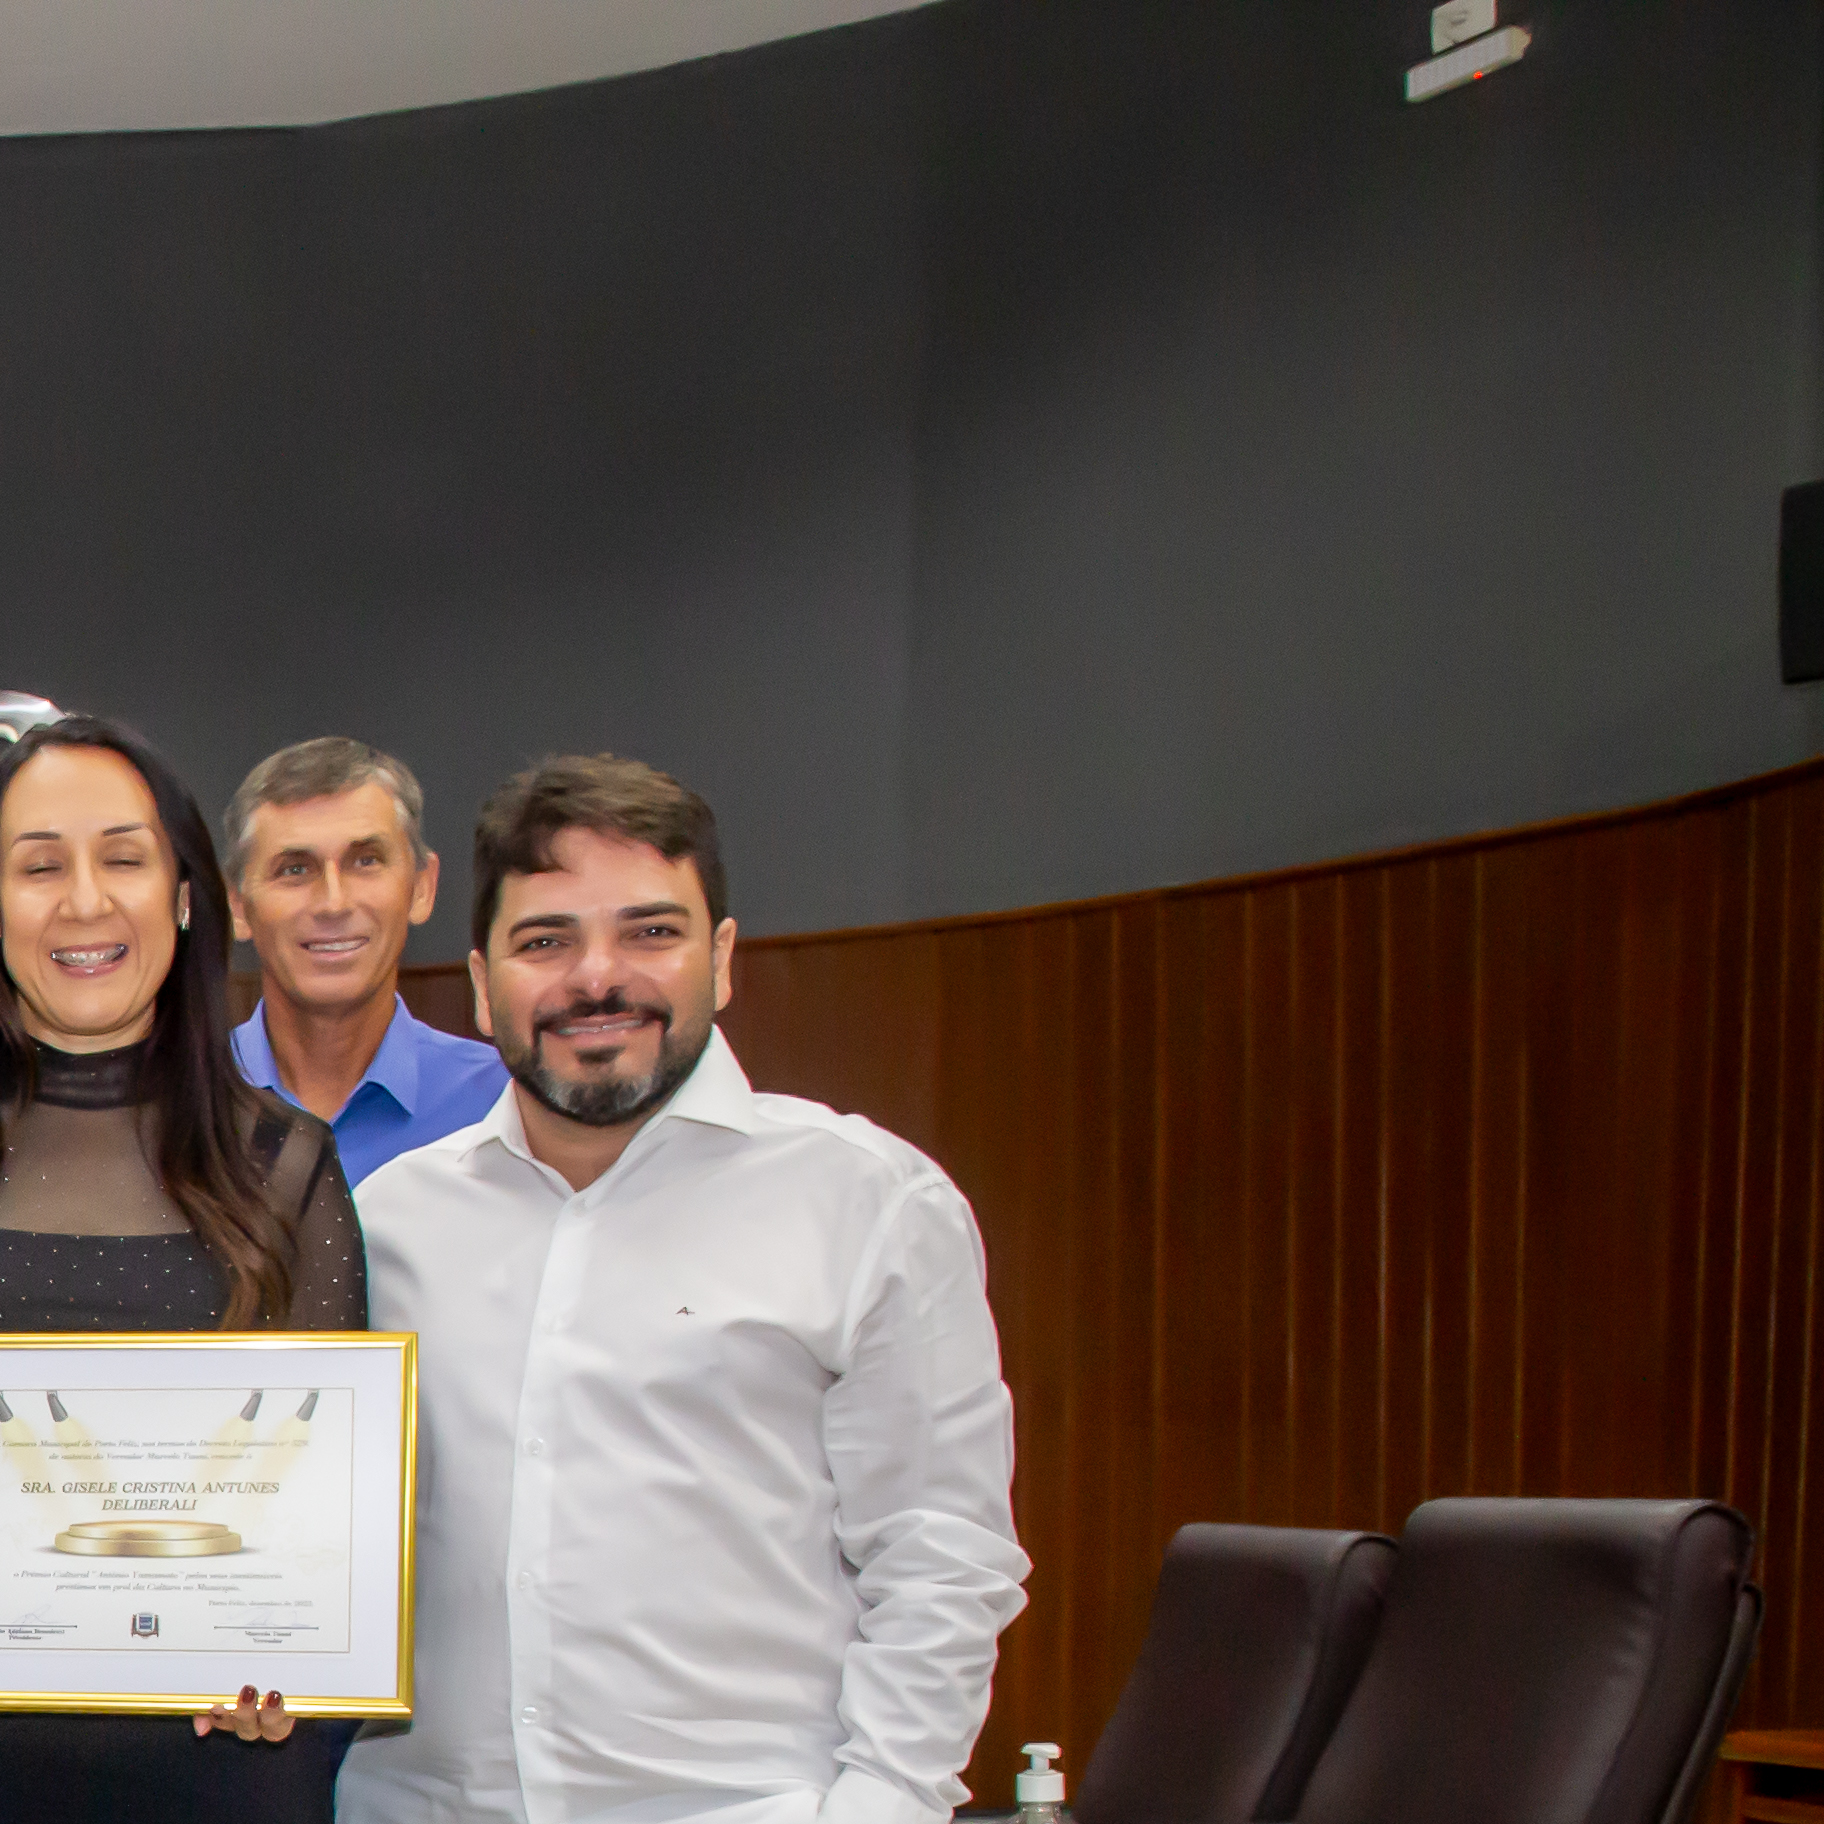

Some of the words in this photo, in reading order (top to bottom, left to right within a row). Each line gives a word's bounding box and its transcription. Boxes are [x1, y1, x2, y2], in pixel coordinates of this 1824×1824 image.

[21, 1482, 55, 1493] SRA.
[62, 1482, 117, 1493] GISELE
[123, 1482, 196, 1493] CRISTINA
[203, 1482, 279, 1493] ANTUNES
[102, 1499, 197, 1510] DELIBERALI
